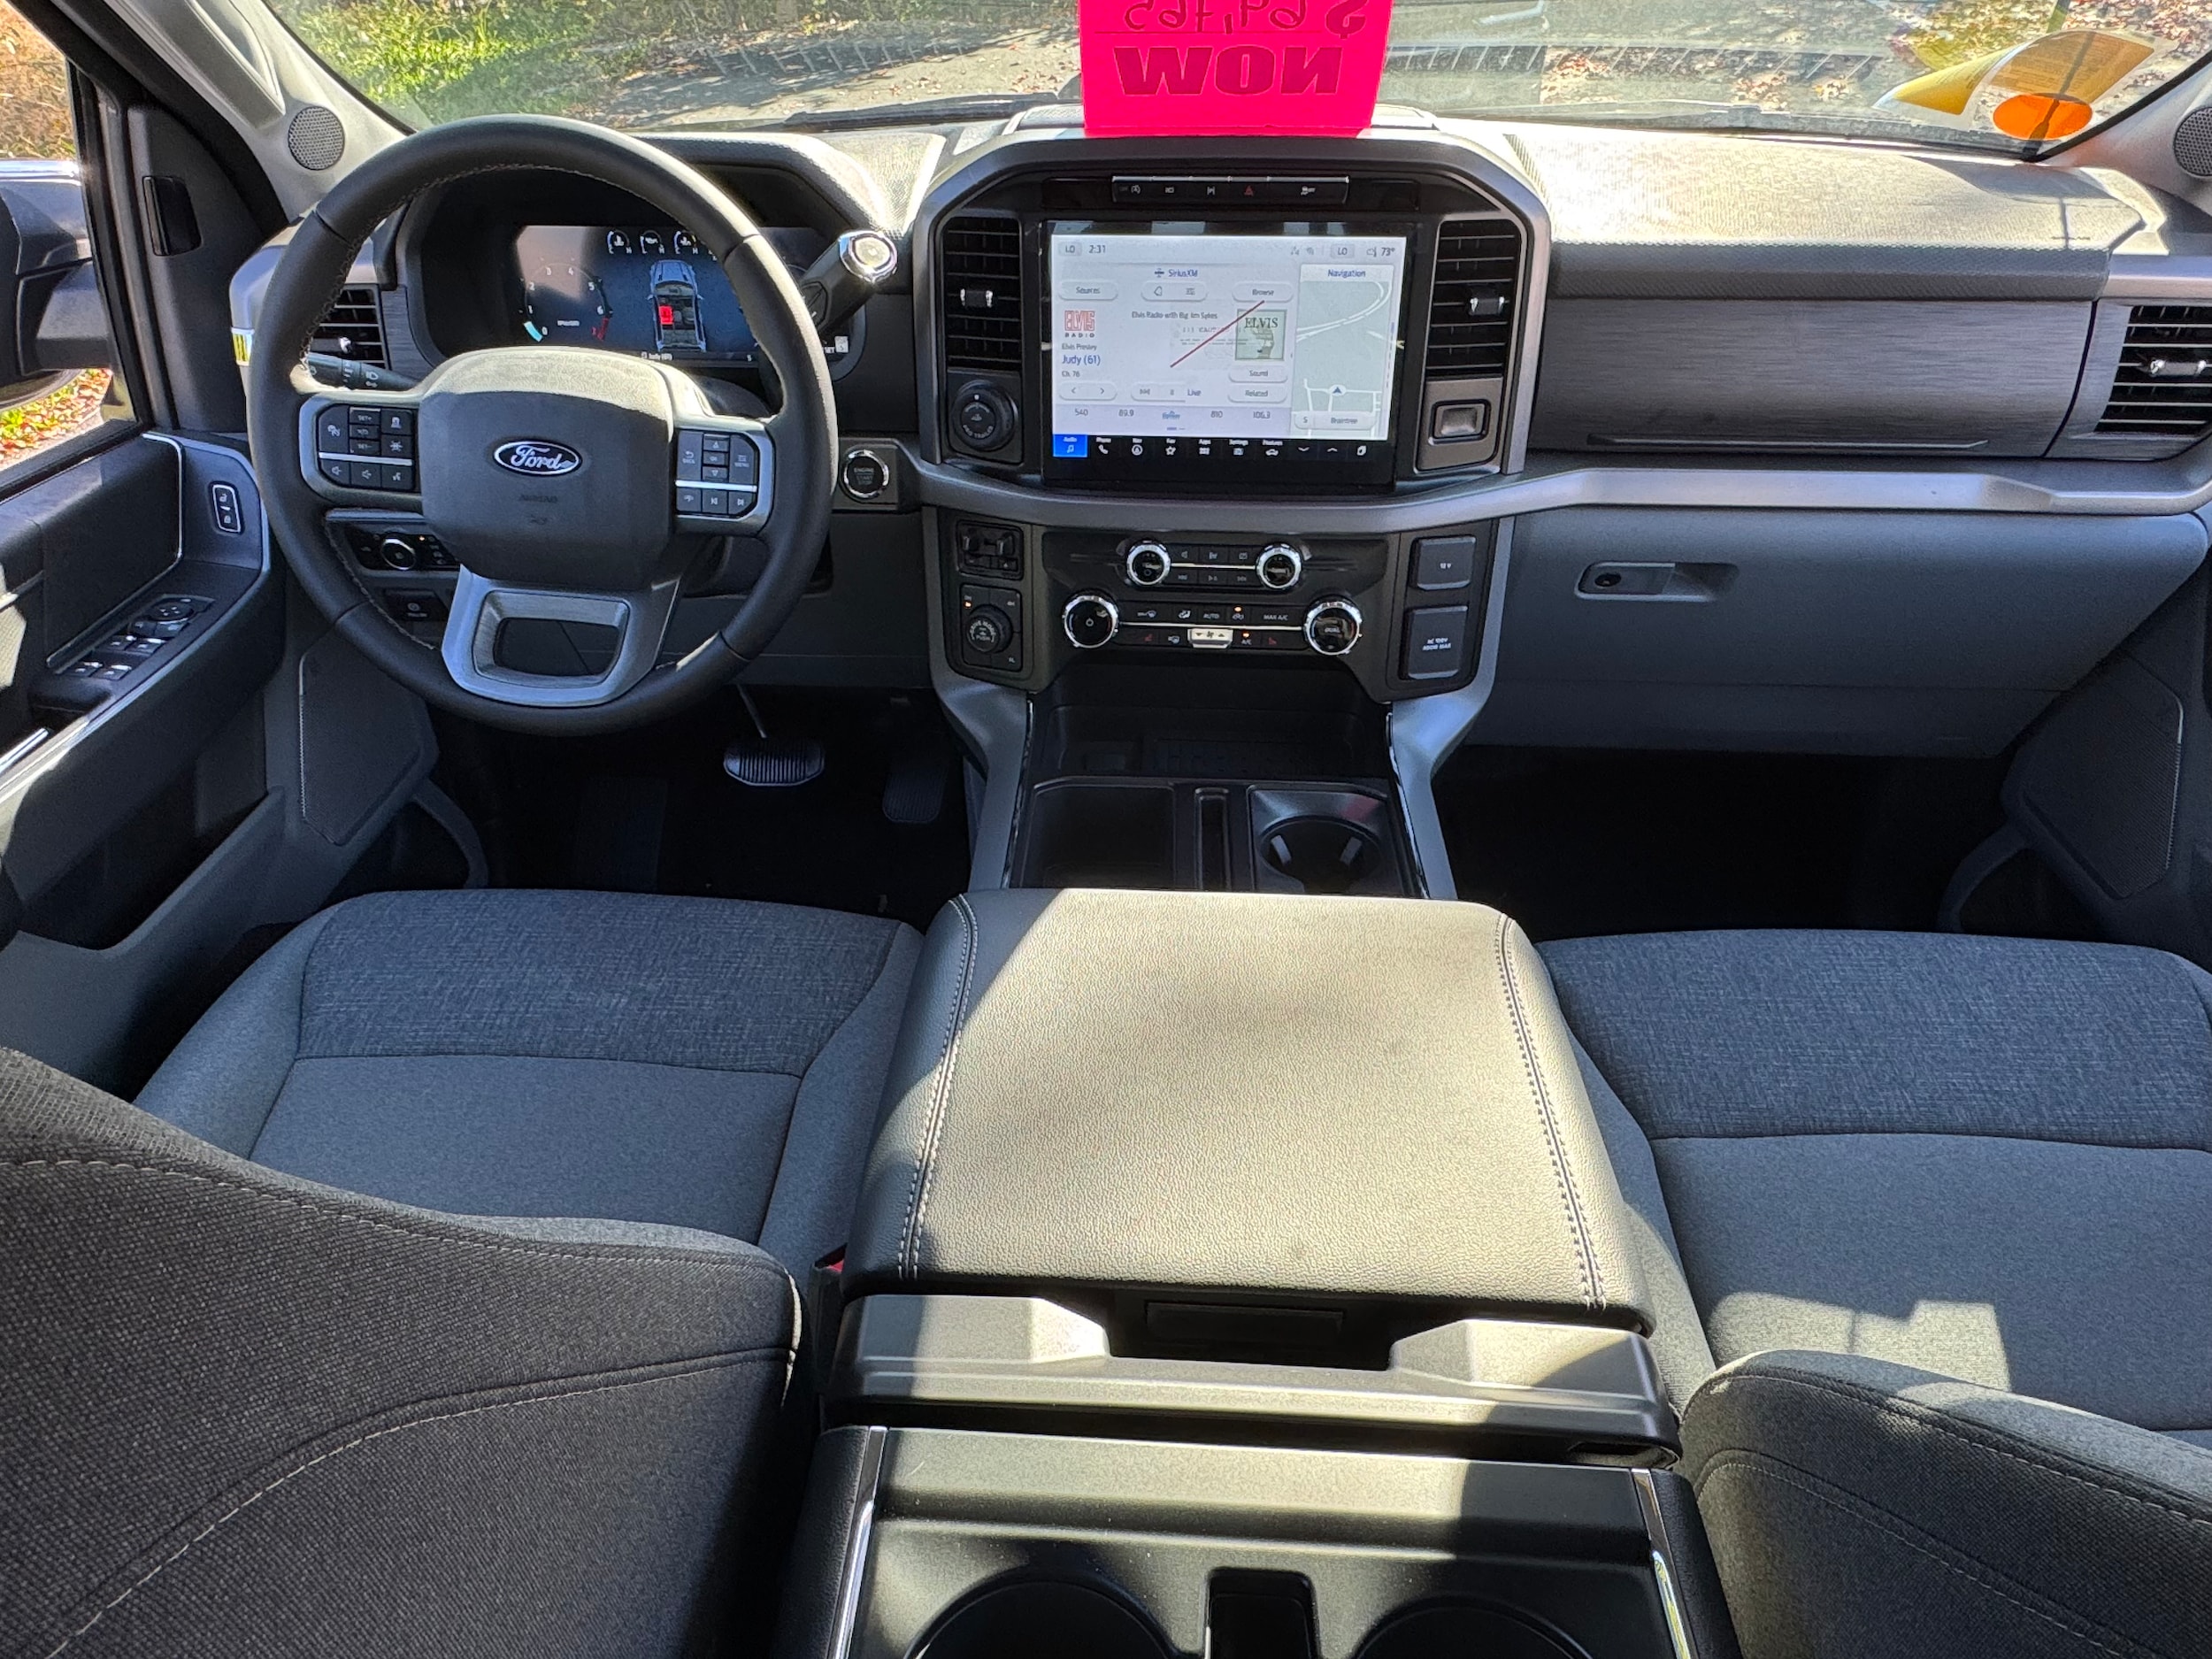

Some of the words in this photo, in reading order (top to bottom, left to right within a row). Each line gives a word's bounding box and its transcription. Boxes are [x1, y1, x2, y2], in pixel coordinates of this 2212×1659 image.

[1088, 244, 1106, 254] 2:31
[1337, 247, 1348, 256] LO
[1380, 247, 1395, 257] 73°
[1168, 269, 1199, 278] SiriusXM
[1327, 269, 1366, 279] Navigation
[588, 282, 595, 291] 5
[1064, 311, 1095, 331] ELVIS
[1244, 317, 1279, 328] ELVIS
[1062, 354, 1082, 365] Judy
[1084, 354, 1101, 366] (61)
[511, 444, 563, 470] Ford
